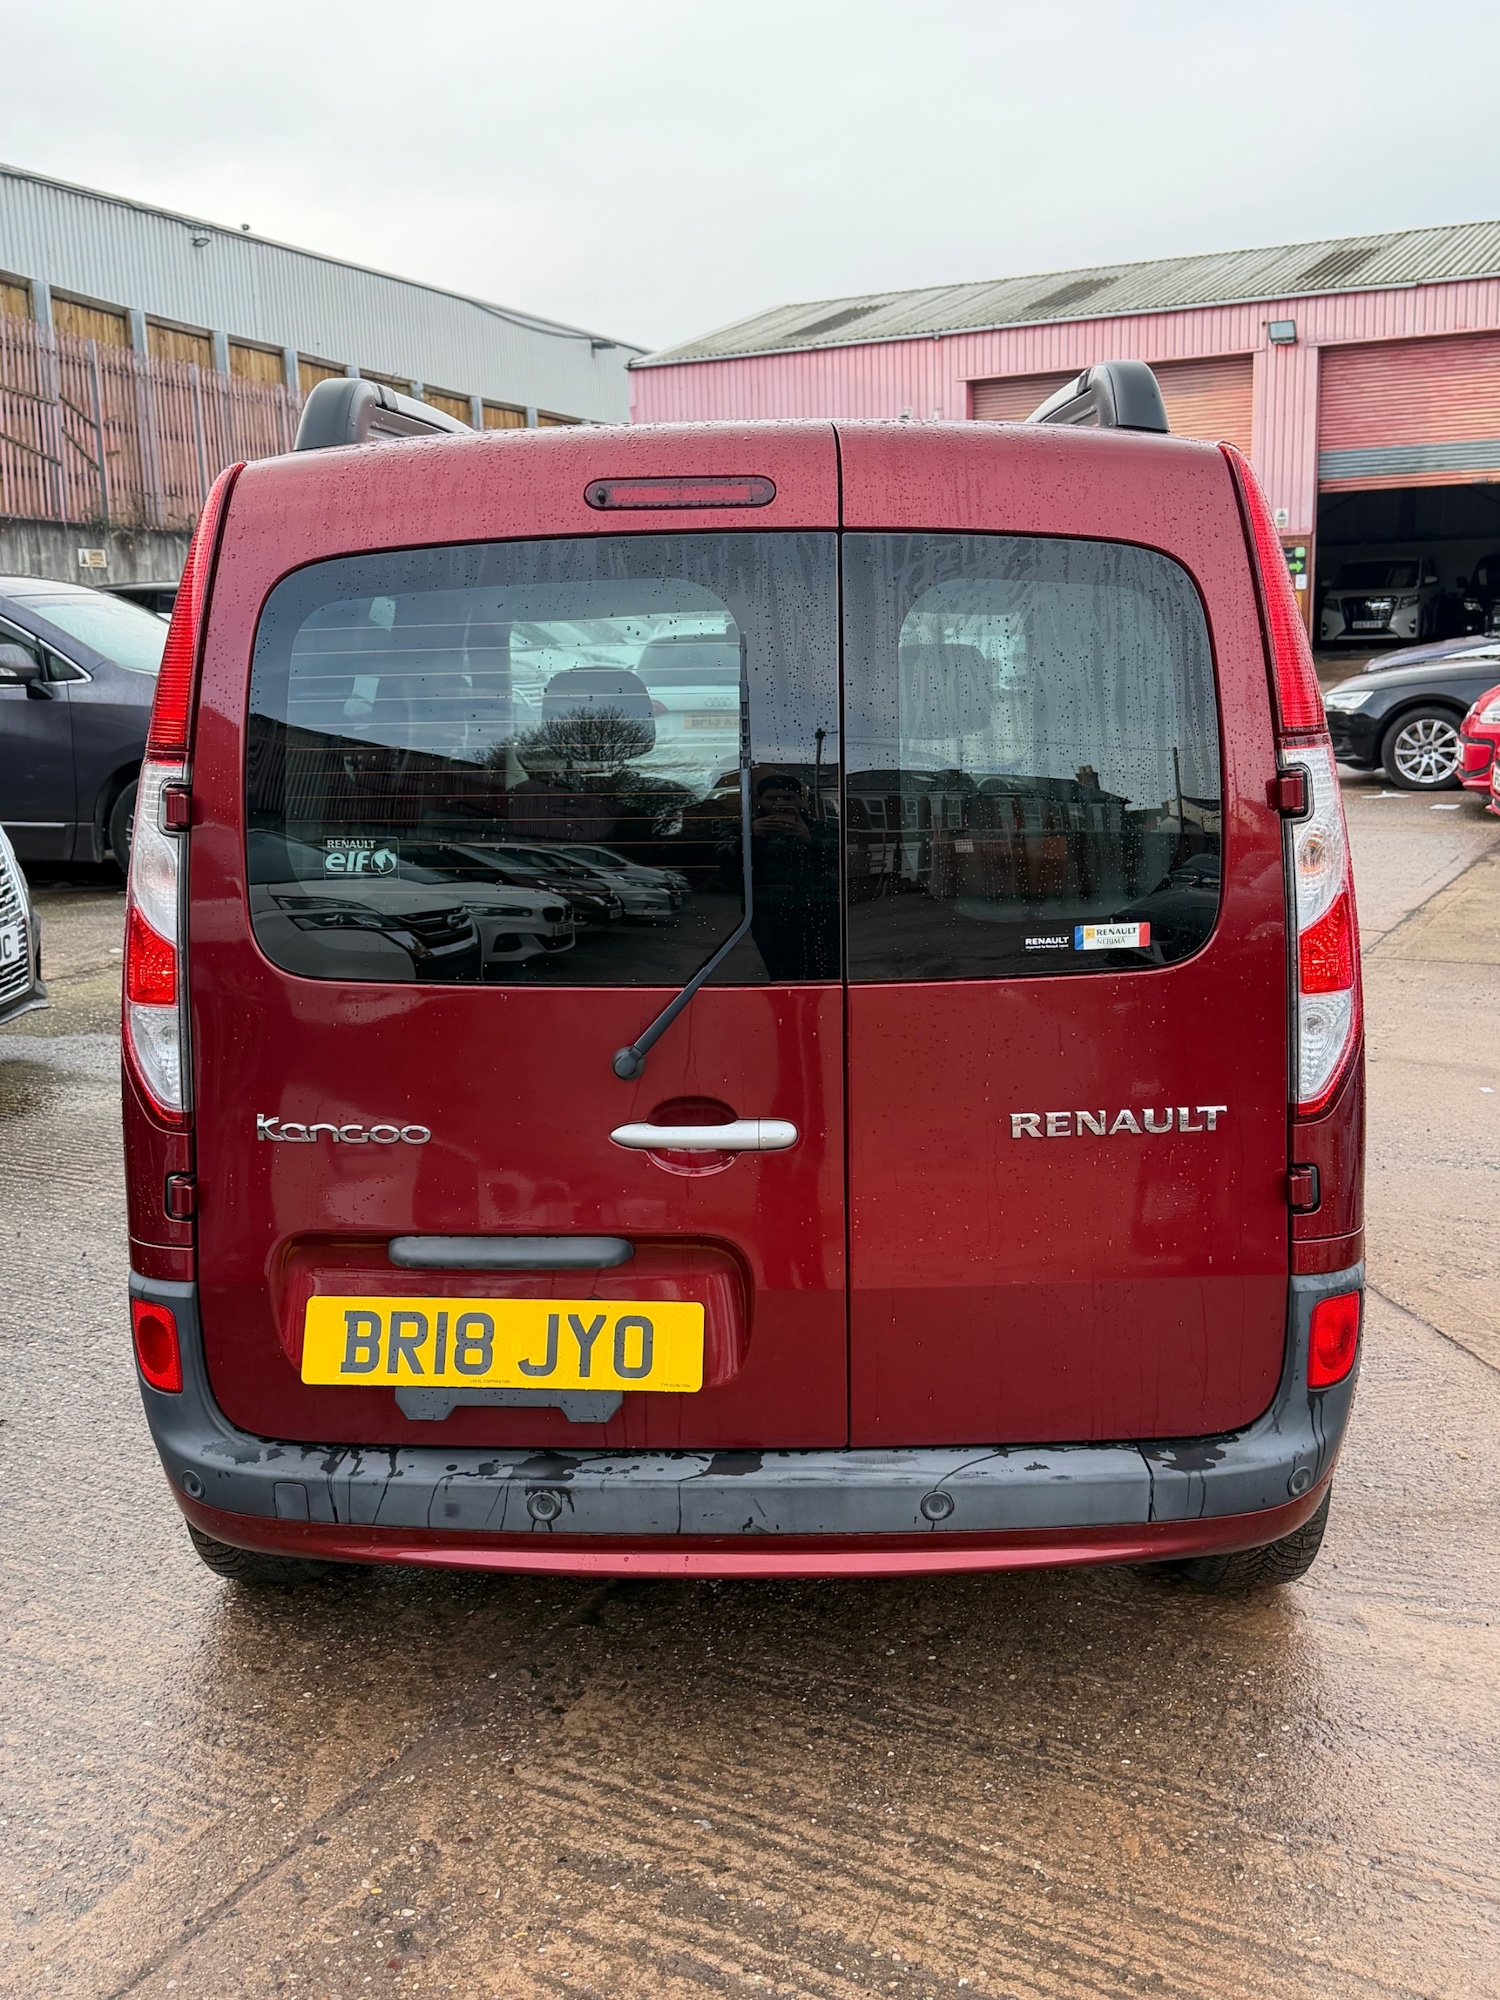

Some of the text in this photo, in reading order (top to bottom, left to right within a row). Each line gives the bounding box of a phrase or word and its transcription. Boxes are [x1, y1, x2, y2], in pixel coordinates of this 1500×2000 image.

[327, 839, 376, 849] RENAULT
[325, 850, 371, 872] elf
[1096, 927, 1137, 936] RENAULT
[1025, 936, 1070, 946] RENAULT
[1096, 936, 1126, 945] NERIMA
[256, 1113, 432, 1145] Kangoo
[1009, 1104, 1228, 1139] RENAULT
[340, 1310, 655, 1378] BR18 JYO
